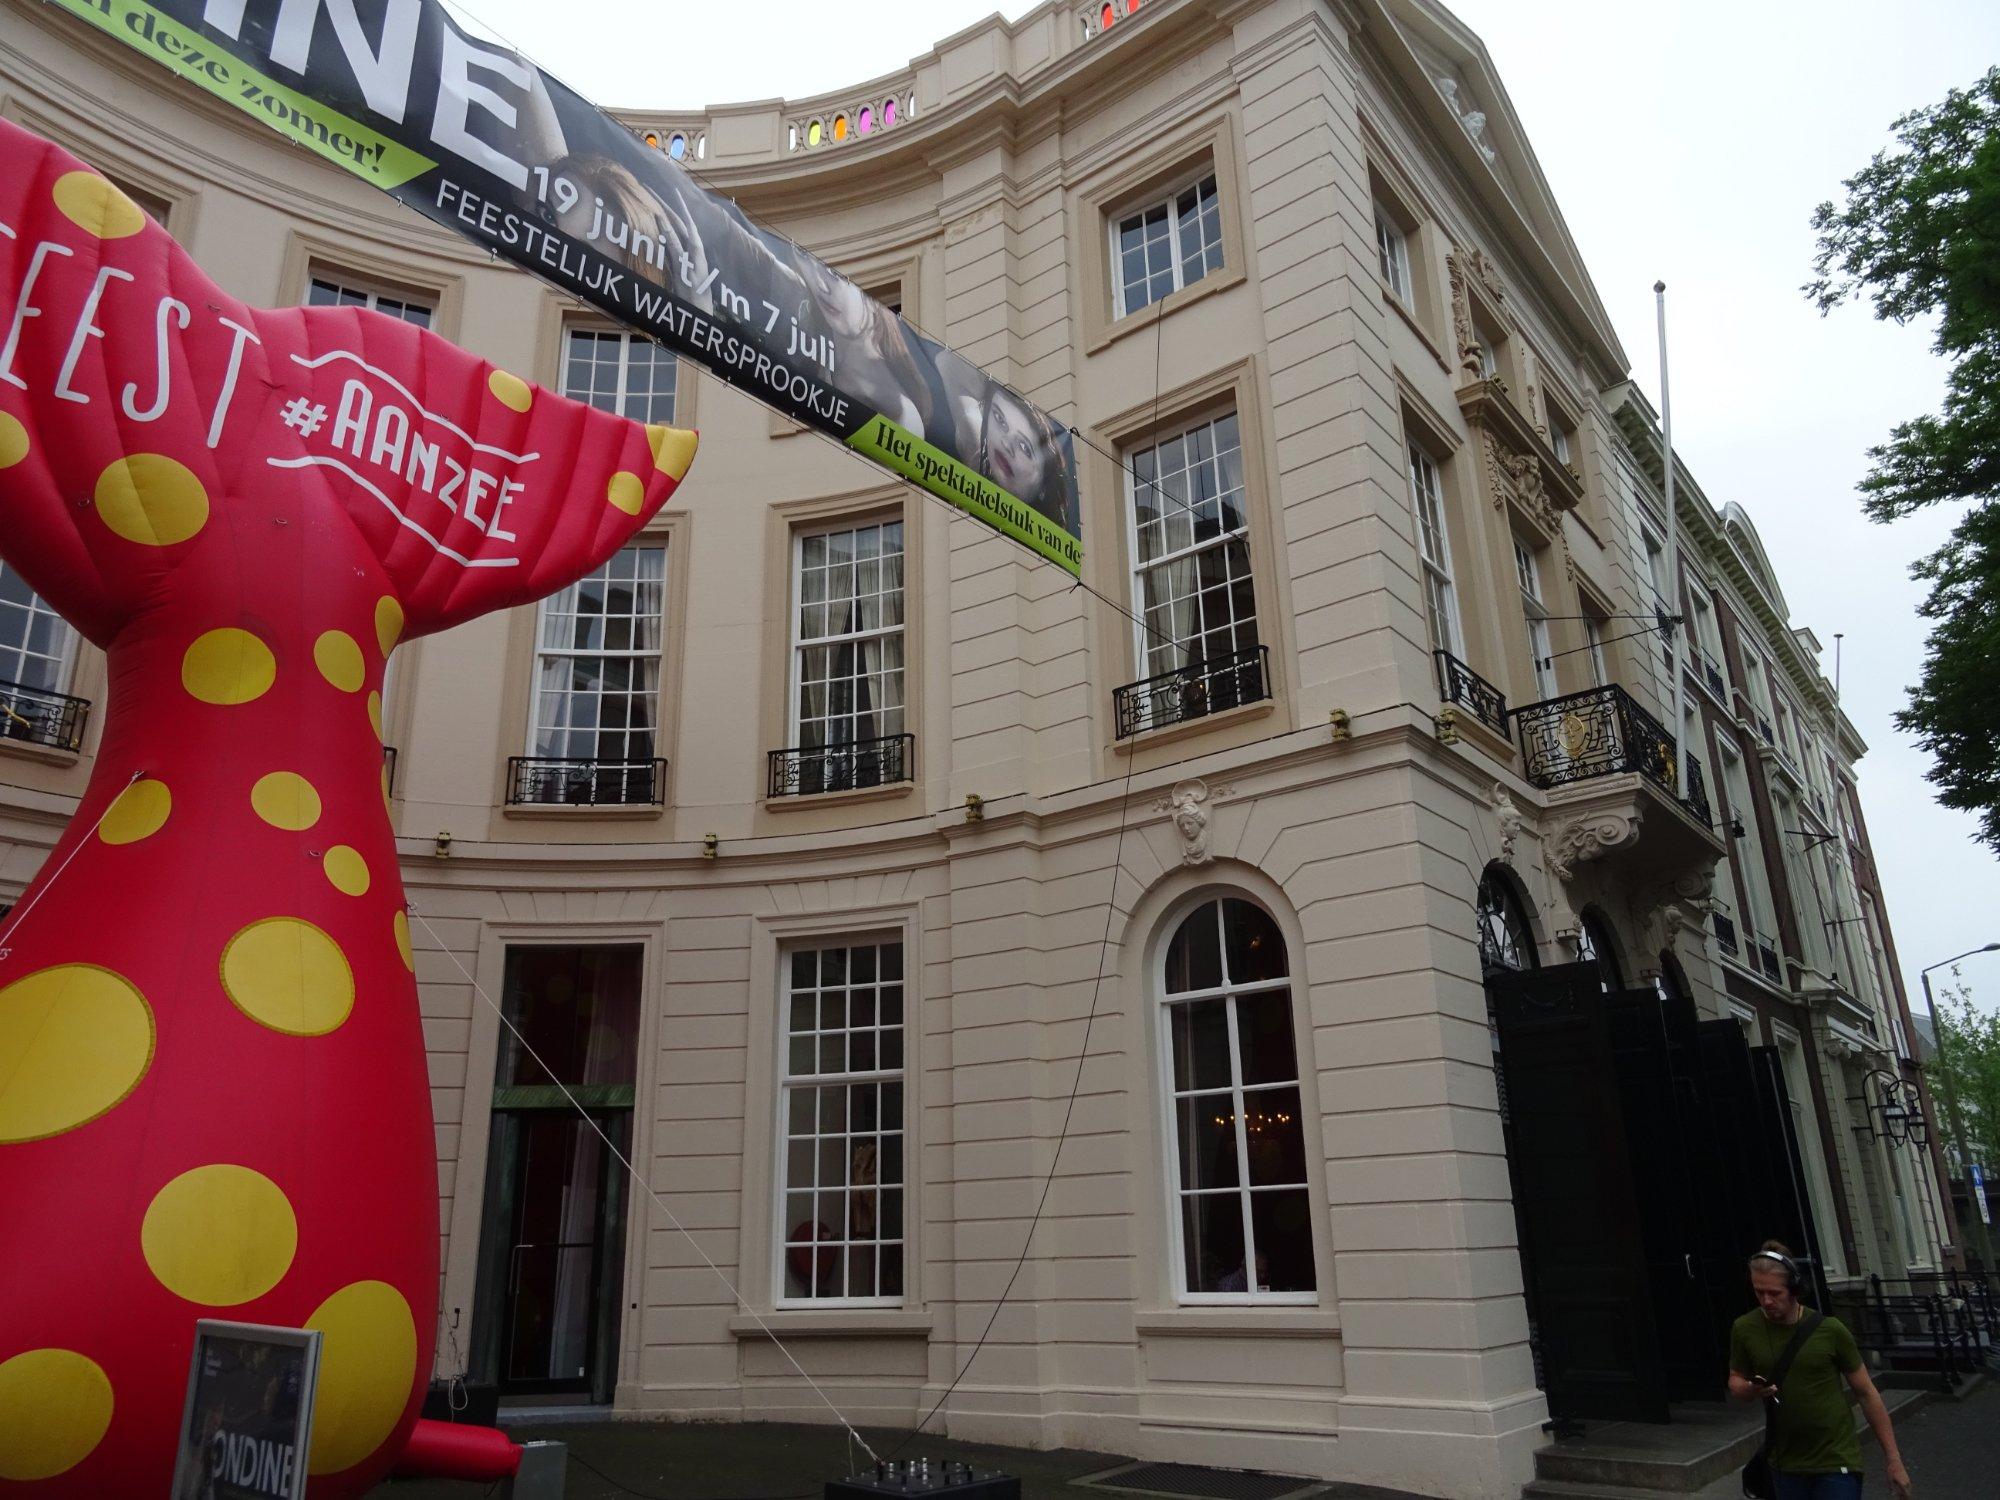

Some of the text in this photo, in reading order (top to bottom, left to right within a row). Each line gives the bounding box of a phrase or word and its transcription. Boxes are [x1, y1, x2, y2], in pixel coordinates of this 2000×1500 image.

[125, 11, 386, 175] deze zomer!
[0, 222, 260, 448] EEST
[436, 179, 849, 427] FEESTELIJK WATERSPROOKJE
[530, 166, 836, 372] 19 juni t/m 7 juli
[280, 379, 525, 542] #AANZEE
[875, 421, 1081, 567] Het spektakelstuk van de
